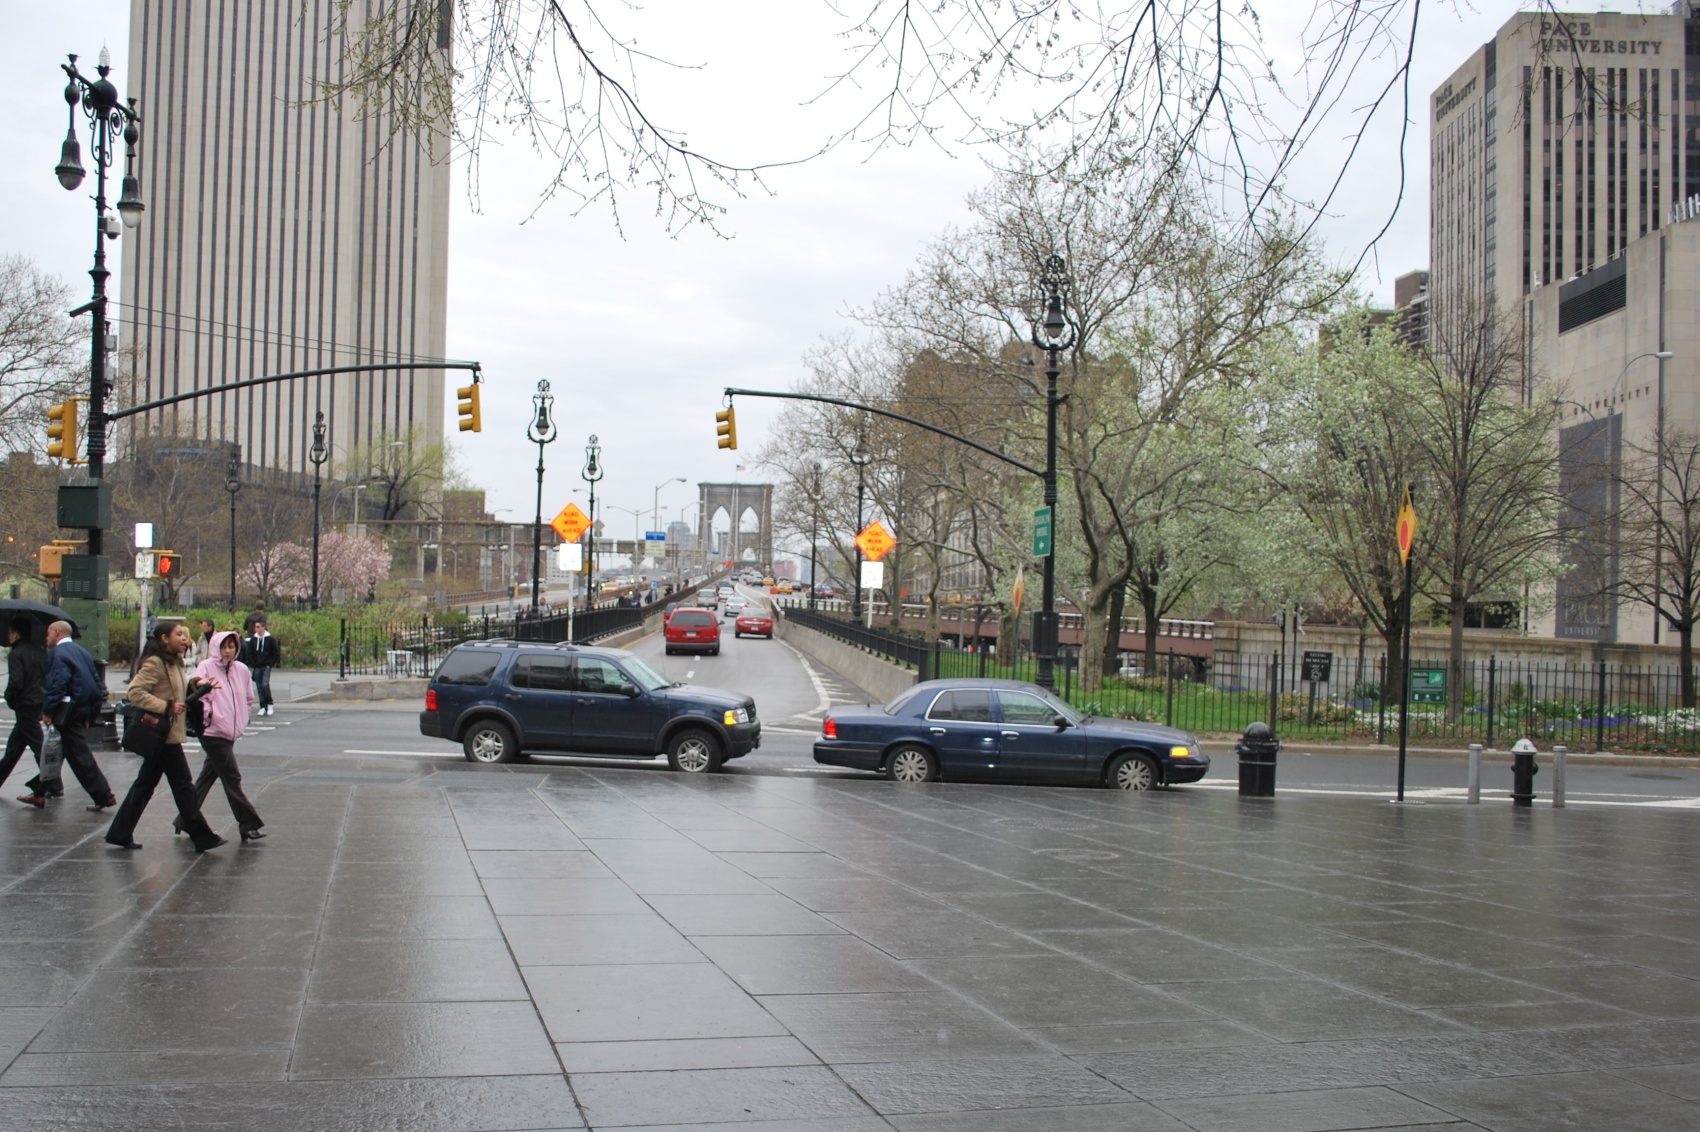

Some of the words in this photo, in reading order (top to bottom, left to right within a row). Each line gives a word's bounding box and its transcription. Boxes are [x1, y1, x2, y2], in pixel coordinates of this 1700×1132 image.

[1541, 21, 1591, 36] PACE
[1542, 38, 1662, 54] UNIVERSITY
[1436, 83, 1453, 108] PACE
[1436, 77, 1477, 123] UNIVERSITY
